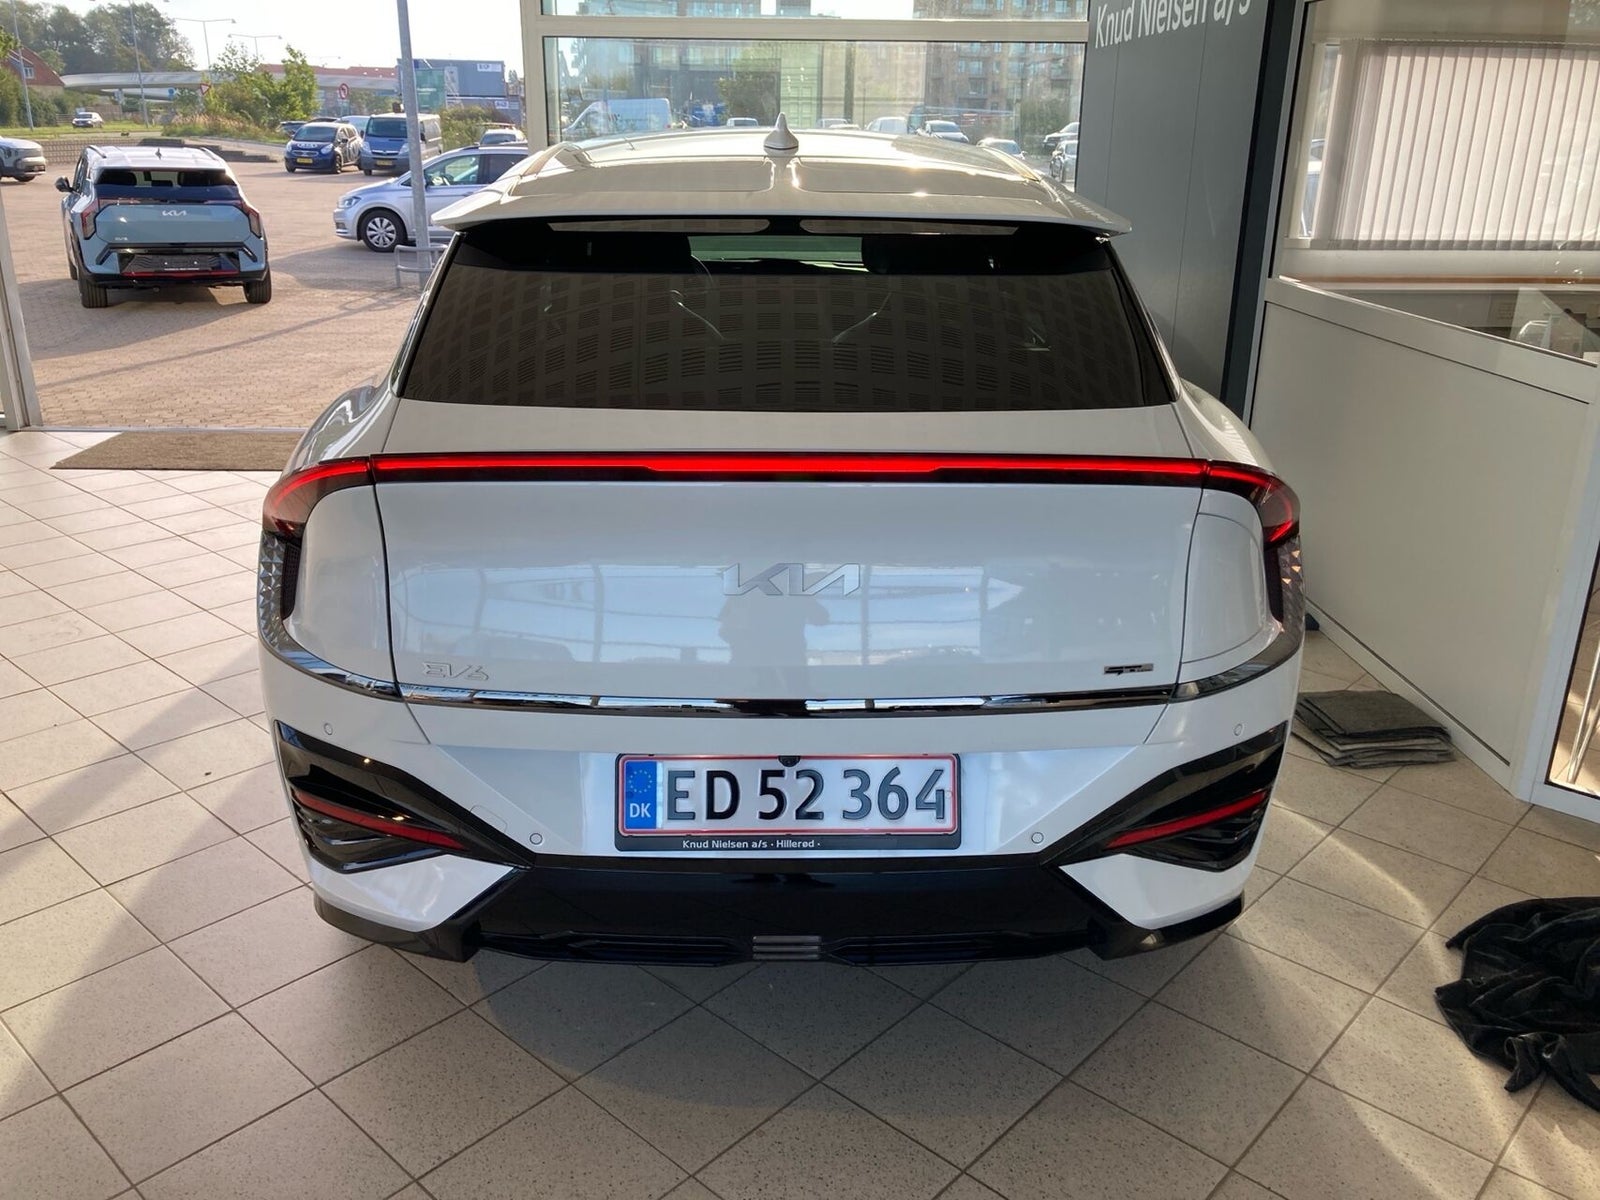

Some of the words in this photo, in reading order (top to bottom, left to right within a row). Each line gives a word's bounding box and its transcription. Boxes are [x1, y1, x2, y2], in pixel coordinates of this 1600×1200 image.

[1095, 0, 1135, 49] Knud
[1137, 0, 1208, 38] Nielsen
[722, 562, 861, 597] KIA
[423, 661, 490, 681] EV6
[667, 770, 740, 821] ED
[757, 770, 824, 821] 52
[842, 767, 946, 821] 364
[629, 803, 652, 819] DK
[682, 840, 709, 849] Knud
[711, 840, 749, 849] Nielsen
[751, 840, 768, 849] a/s
[776, 839, 815, 849] Hillerød
